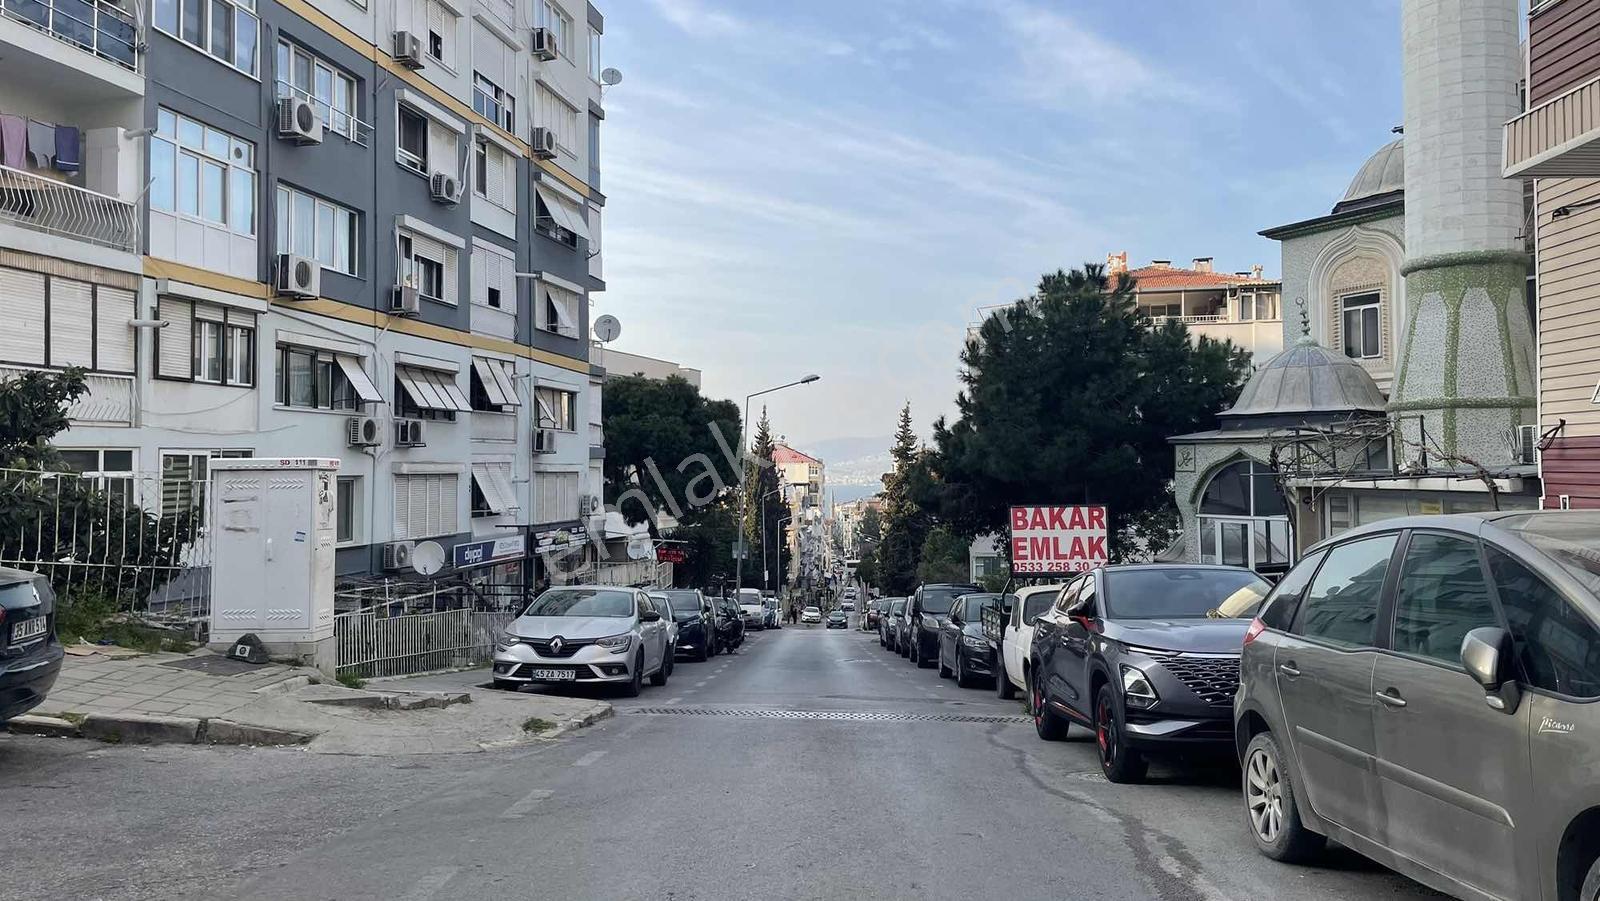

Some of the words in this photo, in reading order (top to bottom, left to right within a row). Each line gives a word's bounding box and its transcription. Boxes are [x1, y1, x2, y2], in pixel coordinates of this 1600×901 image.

[1012, 507, 1106, 530] BAKAR
[1012, 536, 1107, 561] EMLAK
[1013, 562, 1043, 572] 0533
[1047, 562, 1070, 572] 258
[1074, 562, 1090, 572] 30
